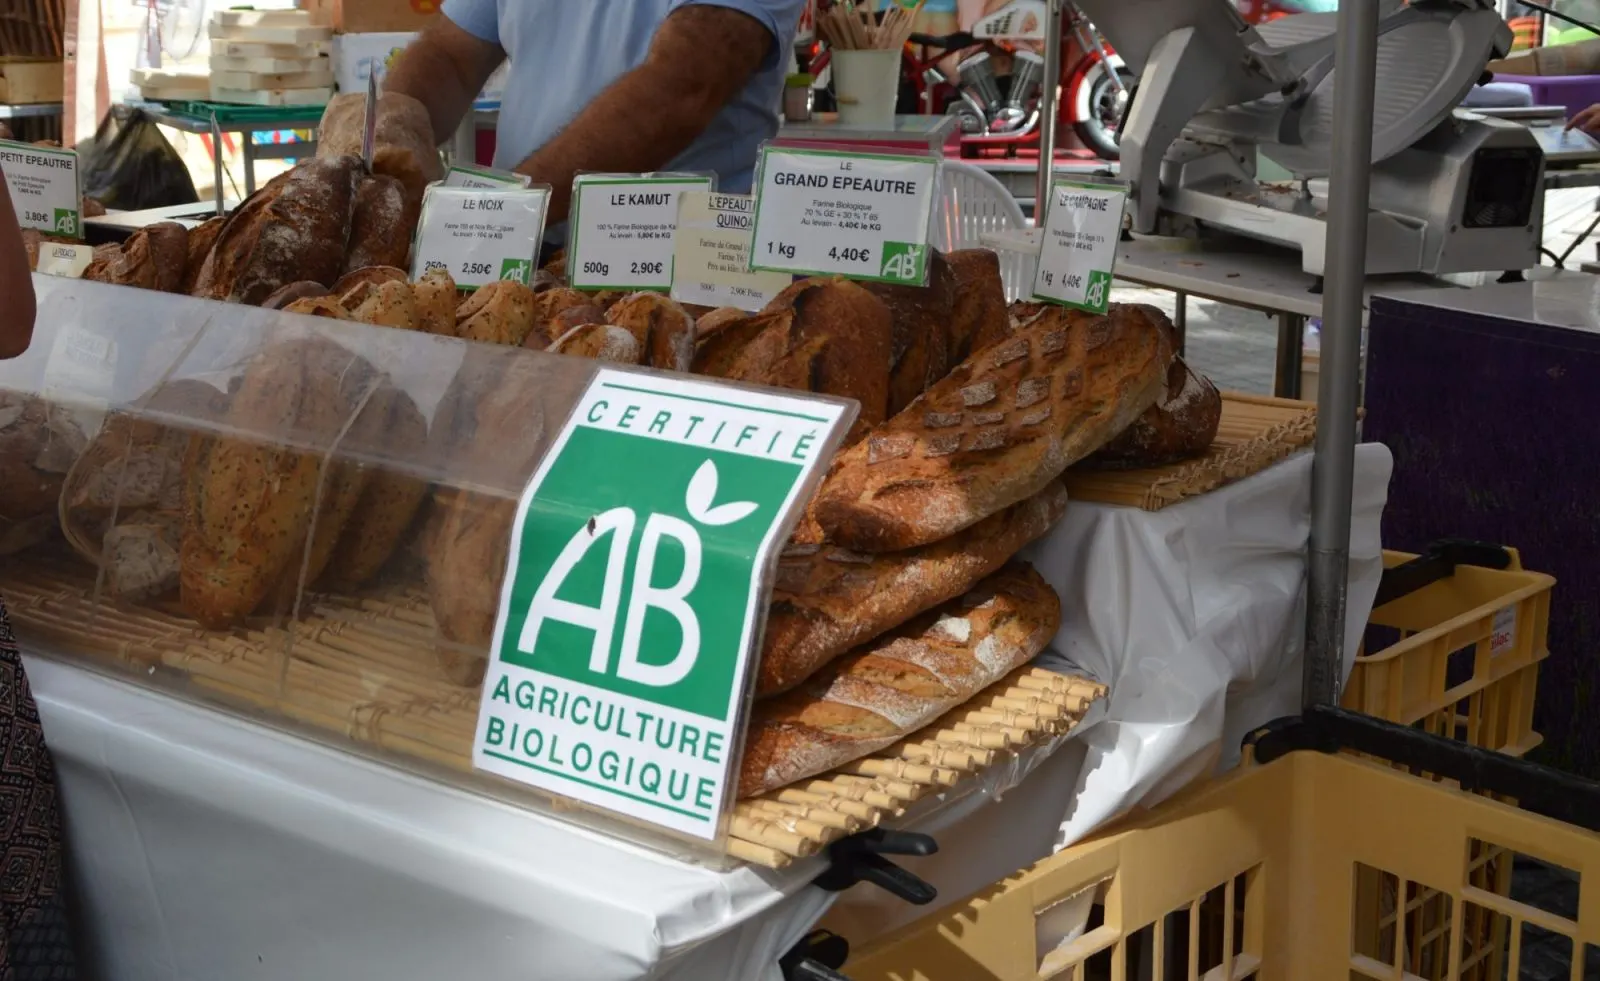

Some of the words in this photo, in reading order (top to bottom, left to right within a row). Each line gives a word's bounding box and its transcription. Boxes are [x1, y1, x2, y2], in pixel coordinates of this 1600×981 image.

[1, 152, 24, 163] PETIT
[26, 155, 72, 170] EPEAUTRE
[840, 162, 853, 171] LE
[774, 172, 828, 188] GRAND
[832, 176, 916, 195] EPEAUTRE
[463, 199, 476, 210] LE
[478, 199, 504, 211] NOIX
[611, 194, 625, 206] LE
[628, 193, 671, 206] KAMUT
[709, 195, 756, 212] L'EPEAUT
[812, 200, 835, 208] Farine
[836, 201, 872, 211] Biologique
[56, 215, 76, 234] AB
[716, 213, 754, 229] QUINOA
[812, 219, 832, 227] levain
[869, 223, 882, 231] KG
[767, 242, 774, 253] 1
[778, 242, 796, 258] kg
[828, 246, 870, 262] 4,40€
[462, 262, 492, 276] 2,50€
[583, 262, 609, 276] 500g
[630, 262, 663, 275] 2,90€
[882, 254, 916, 279] AB
[1045, 270, 1053, 286] kg
[1062, 273, 1082, 289] 4,40€
[587, 400, 816, 460] CERTIFIÉ
[517, 506, 702, 687] AB
[492, 675, 724, 764] AGRICULTURE
[485, 716, 716, 810] BIOLOGIQUE
